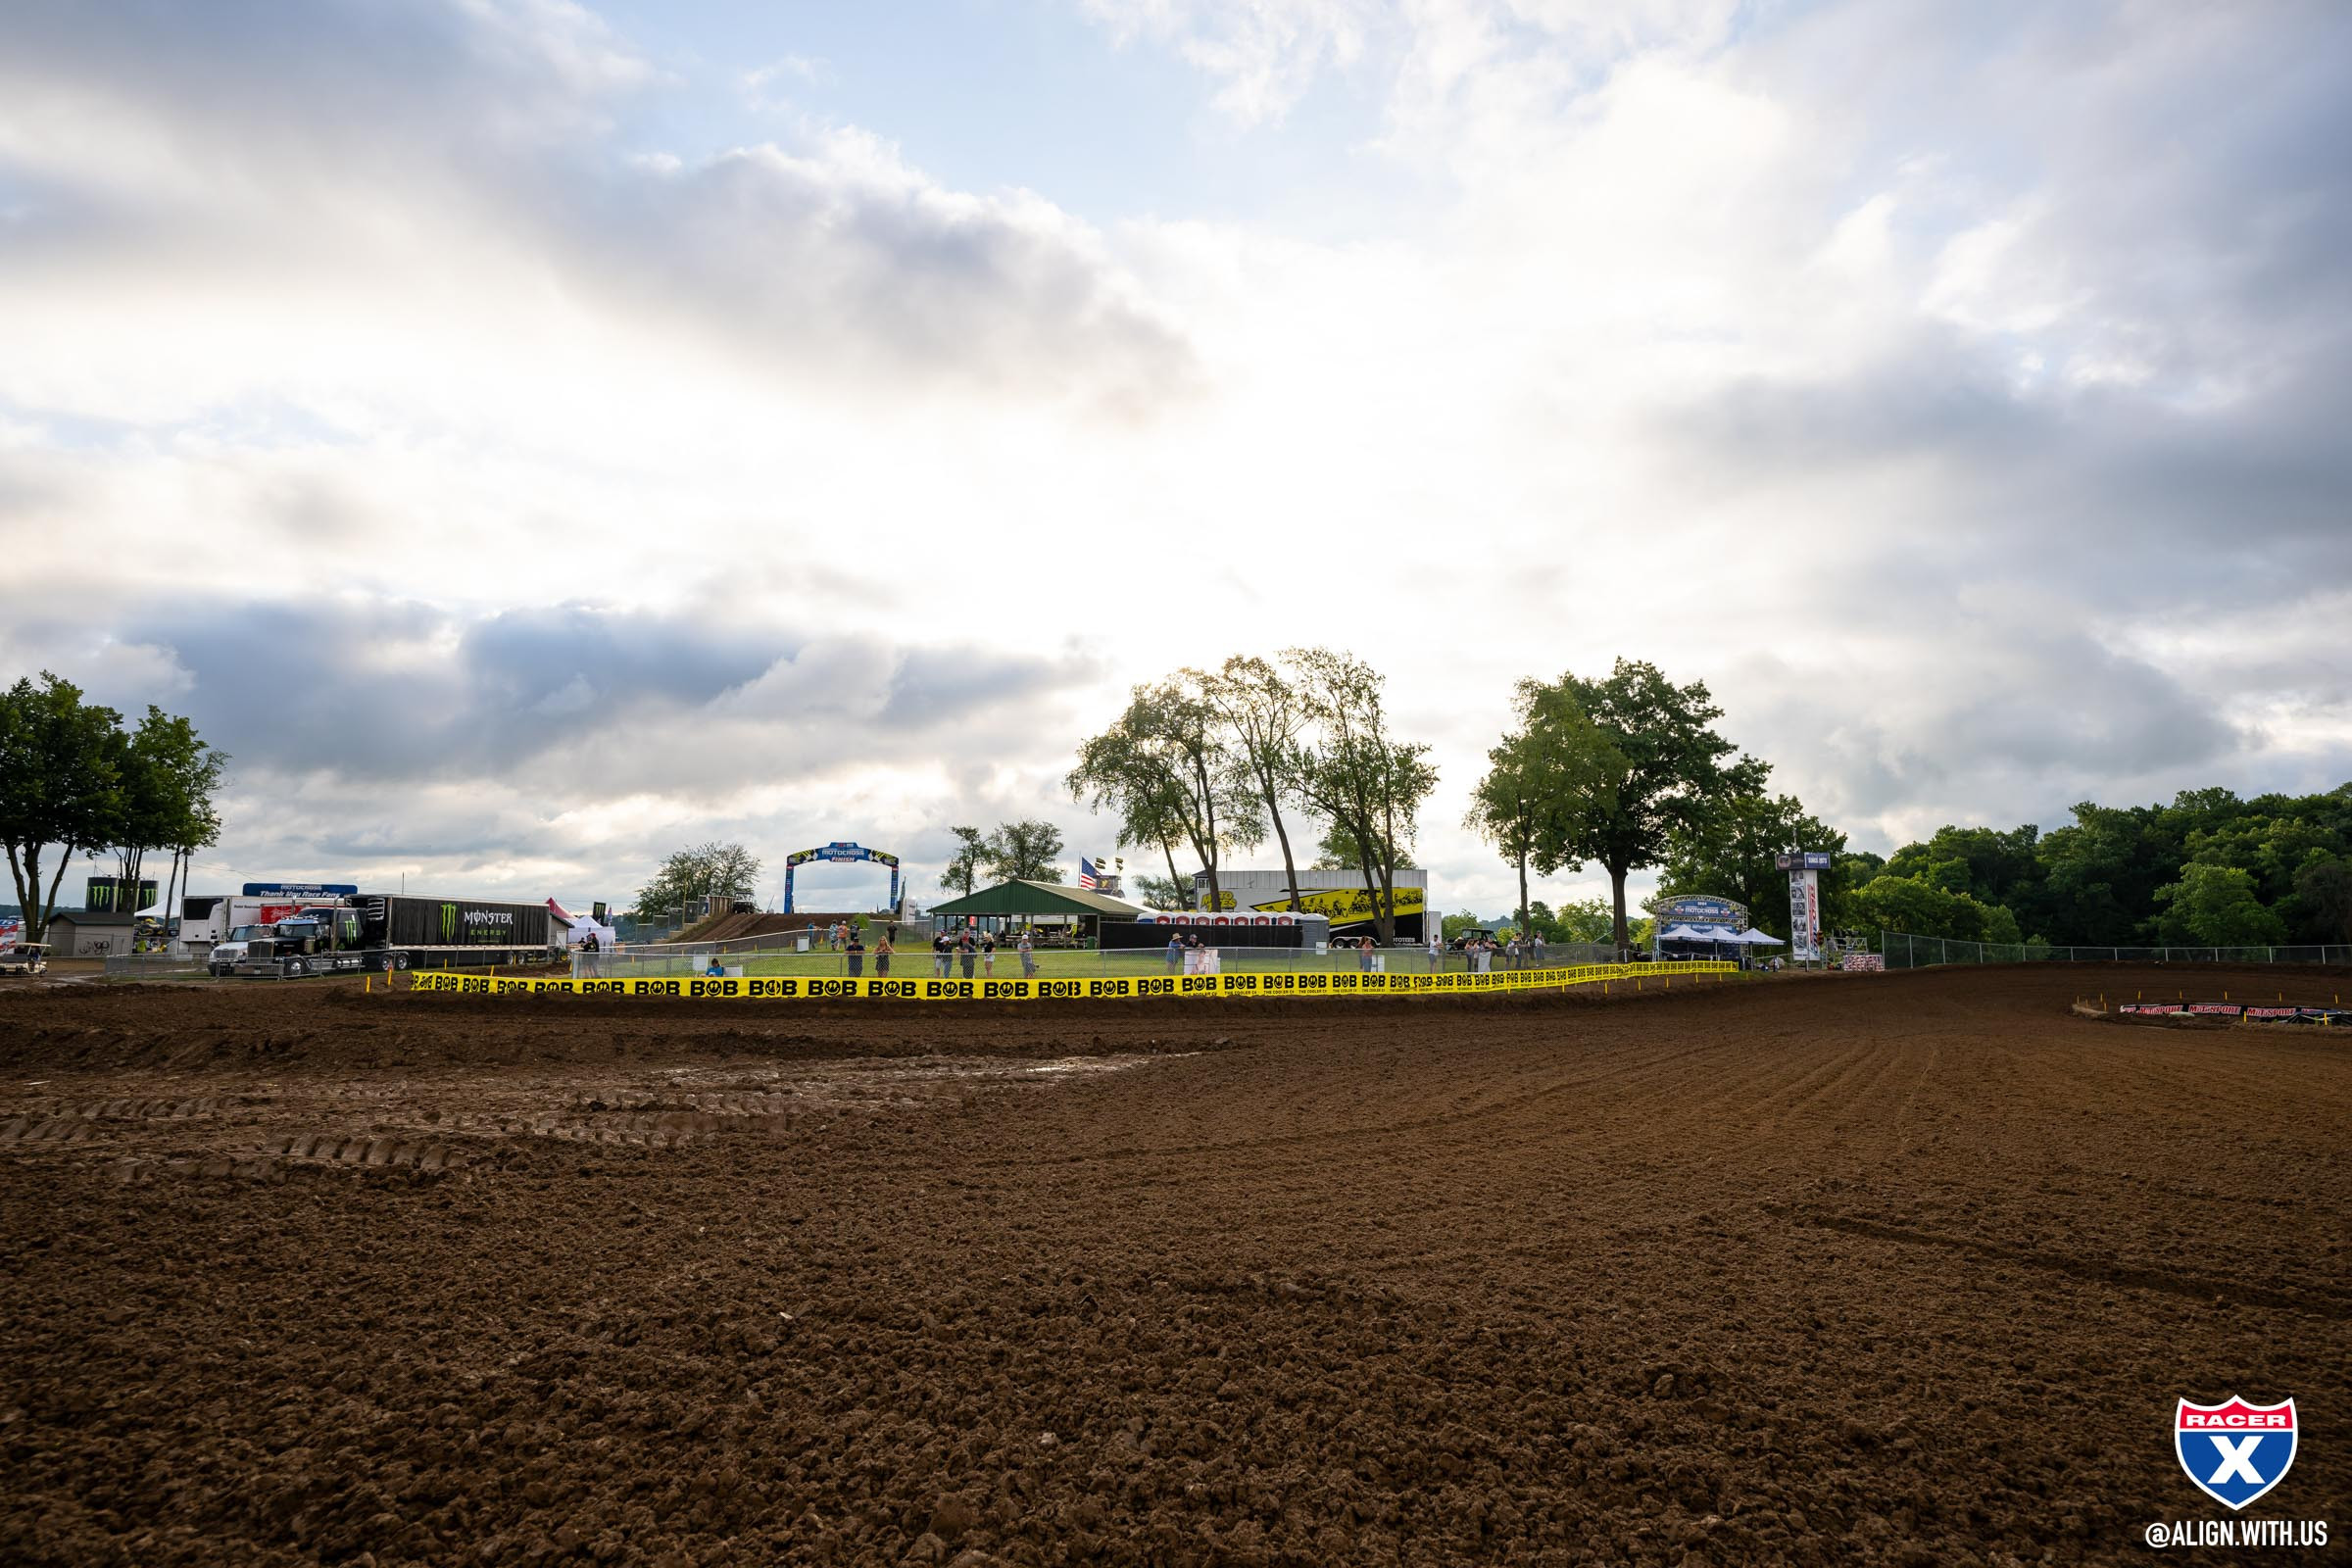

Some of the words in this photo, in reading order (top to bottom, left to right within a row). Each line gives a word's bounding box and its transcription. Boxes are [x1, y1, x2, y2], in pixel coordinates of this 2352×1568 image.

[465, 909, 513, 925] MONSTER
[463, 978, 489, 993] BOB
[635, 981, 680, 995] BOB
[690, 980, 738, 996] BOB
[749, 980, 797, 996] BOB
[808, 980, 857, 996] BOB
[868, 981, 916, 996] BOB
[927, 982, 974, 997] BOB
[984, 982, 1029, 997] BOB
[1038, 981, 1081, 996] BOB
[1090, 980, 1129, 995] BOB
[1138, 979, 1175, 994] BOB
[1182, 977, 1217, 991] BOB
[1224, 976, 1257, 989] BOB
[1264, 976, 1294, 989] BOB
[1298, 975, 1326, 988] BOB
[1333, 975, 1357, 988] BOB
[1362, 975, 1385, 987] BOB
[1391, 976, 1410, 988] BOB
